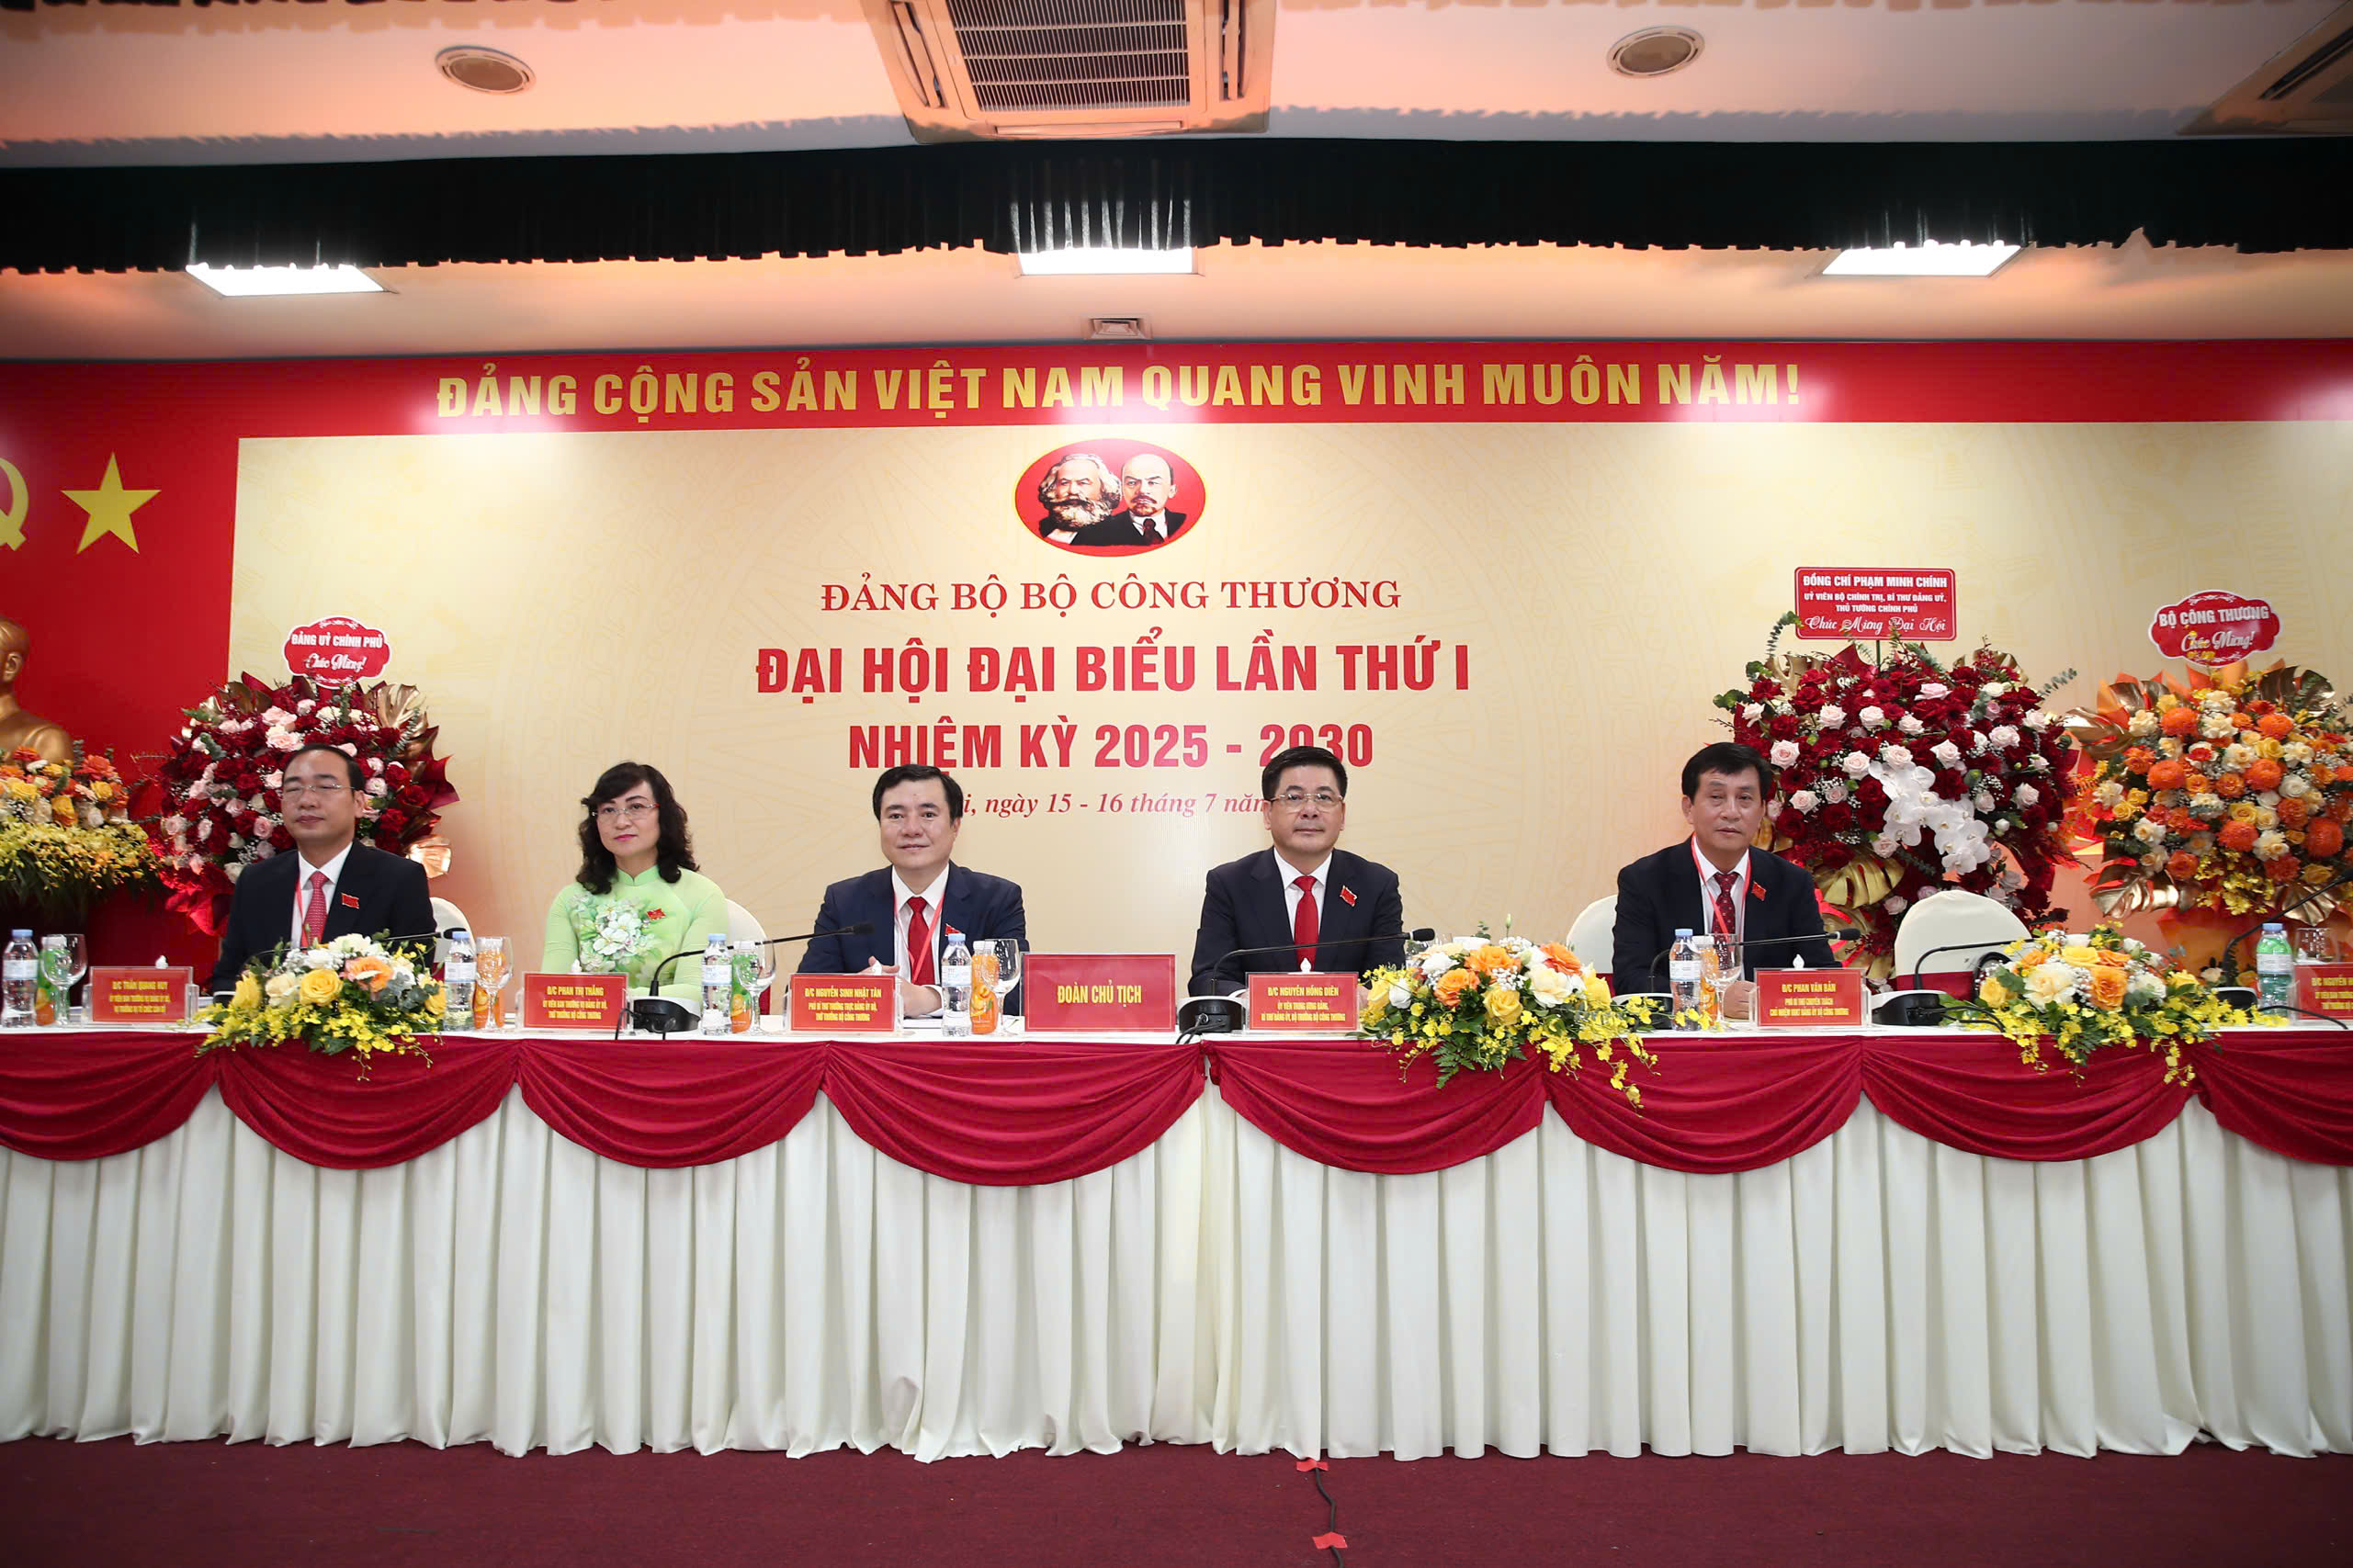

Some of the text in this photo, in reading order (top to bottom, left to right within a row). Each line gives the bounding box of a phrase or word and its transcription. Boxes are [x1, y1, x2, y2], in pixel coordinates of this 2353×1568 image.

[437, 355, 1800, 423] ĐẢNG CỘNG SẢN VIỆT NAM QUANG VINH MUÔN NĂM!
[1803, 572, 1947, 589] ĐỒNG CHÍ PHẠM MINH CHÍNH
[821, 572, 1400, 617] ĐẢNG BỘ BỘ CÔNG THƯƠNG
[1816, 592, 1833, 601] VIÊN
[1835, 592, 1845, 602] BỘ
[1847, 592, 1870, 601] CHÍNH
[1887, 592, 1895, 602] BÍ
[1896, 593, 1912, 602] THƯ
[1912, 592, 1933, 602] ĐẢNG
[1836, 603, 1850, 612] THỦ
[1878, 604, 1901, 613] CHÍNH
[1902, 603, 1918, 613] PHỦ
[2159, 605, 2269, 628] BỘ CÔNG THƯƠNG
[1804, 615, 1838, 629] Chúc
[1889, 616, 1915, 633] Đại
[1919, 616, 1946, 633] Hội
[291, 631, 317, 646] ĐẢNG
[333, 634, 362, 648] CHÍNH
[363, 634, 383, 649] PHỦ
[756, 626, 1468, 704] ĐẠI HỘI ĐẠI BIỂU LẦN THỨ I
[850, 716, 1001, 775] NHIỆM
[1022, 715, 1078, 768] KỲ
[1095, 724, 1208, 768] 2025
[1227, 745, 1241, 753] -
[985, 793, 1039, 818] ngày
[1047, 793, 1072, 814] 15
[1098, 793, 1124, 814] 16
[1131, 793, 1197, 818] tháng
[1205, 793, 1217, 814] 7
[558, 986, 574, 996] PHAN
[839, 987, 854, 998] SINH
[1058, 979, 1142, 1008] ĐOÀN CHỦ TỊCH
[1268, 987, 1279, 997] Đ/C
[1793, 984, 1810, 993] PHAN
